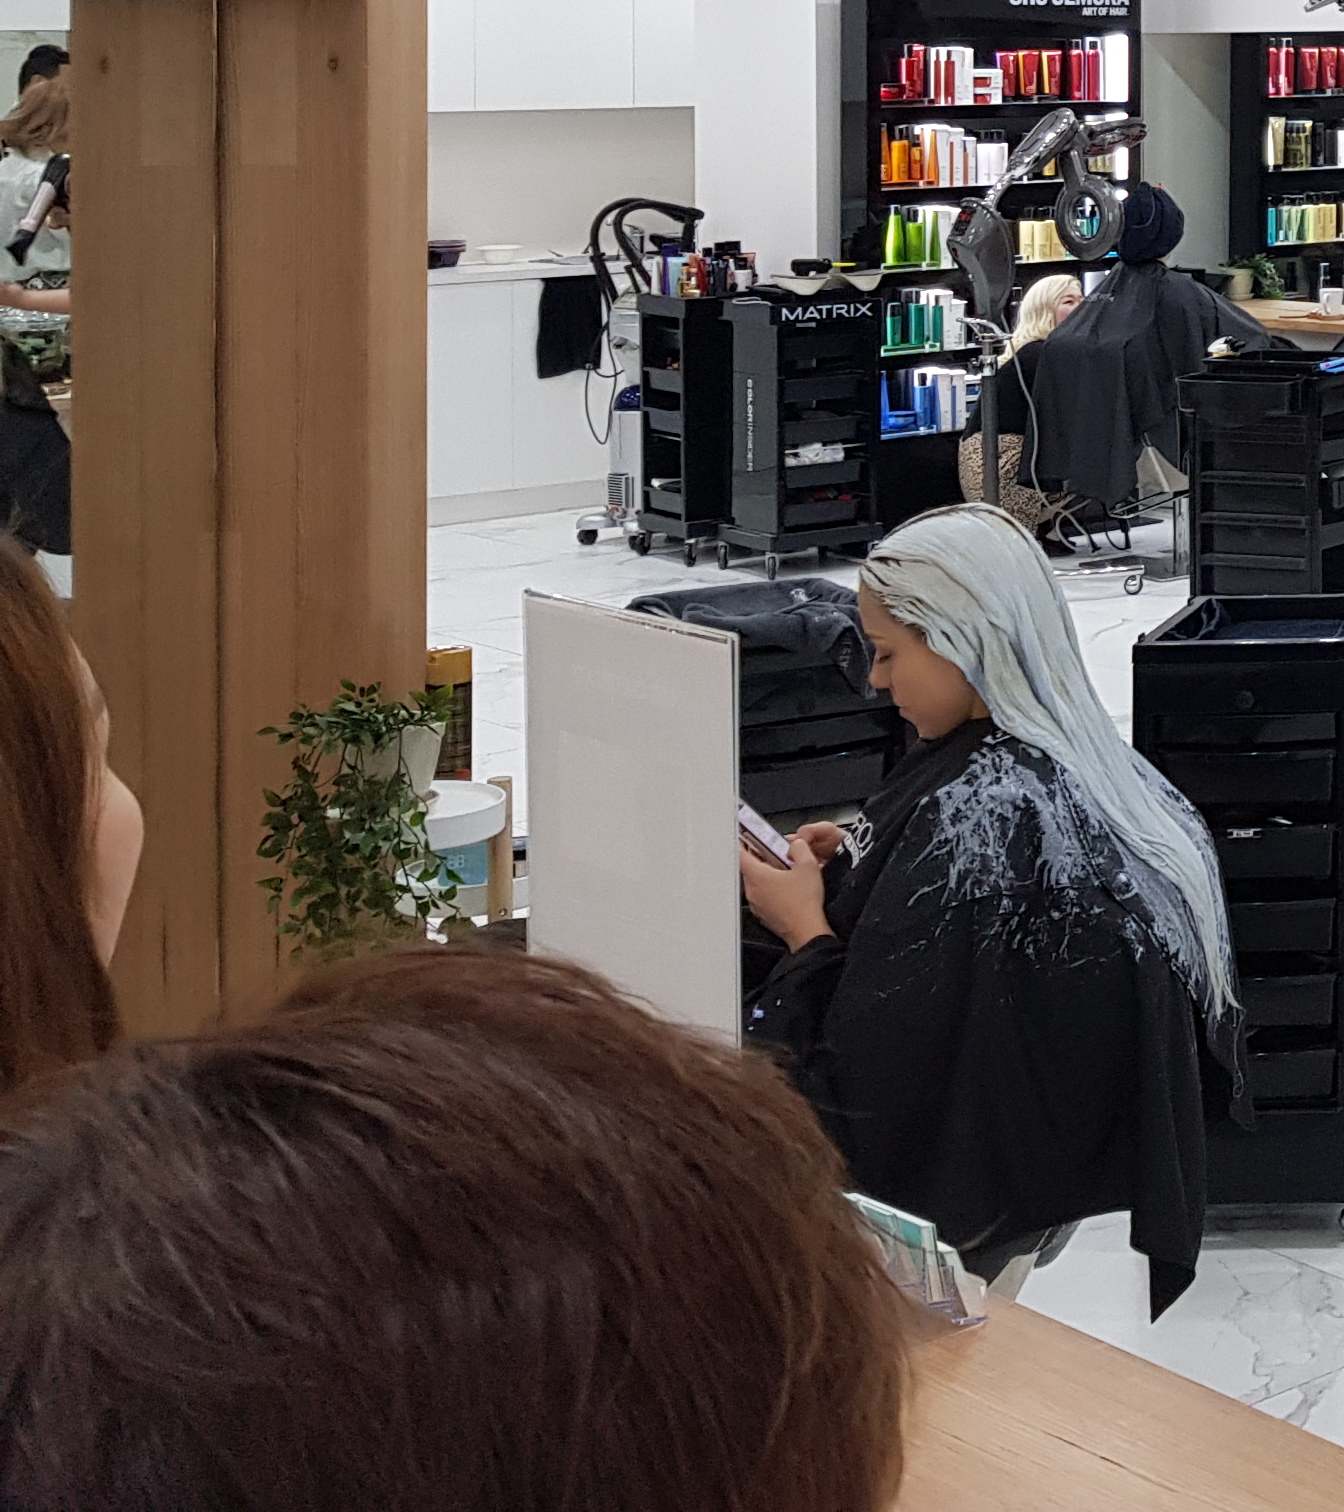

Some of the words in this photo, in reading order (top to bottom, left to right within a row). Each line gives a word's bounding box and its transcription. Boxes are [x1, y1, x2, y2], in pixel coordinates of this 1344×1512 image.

[1081, 7, 1097, 16] ART
[1098, 7, 1109, 16] OF
[781, 302, 873, 322] MATRIX
